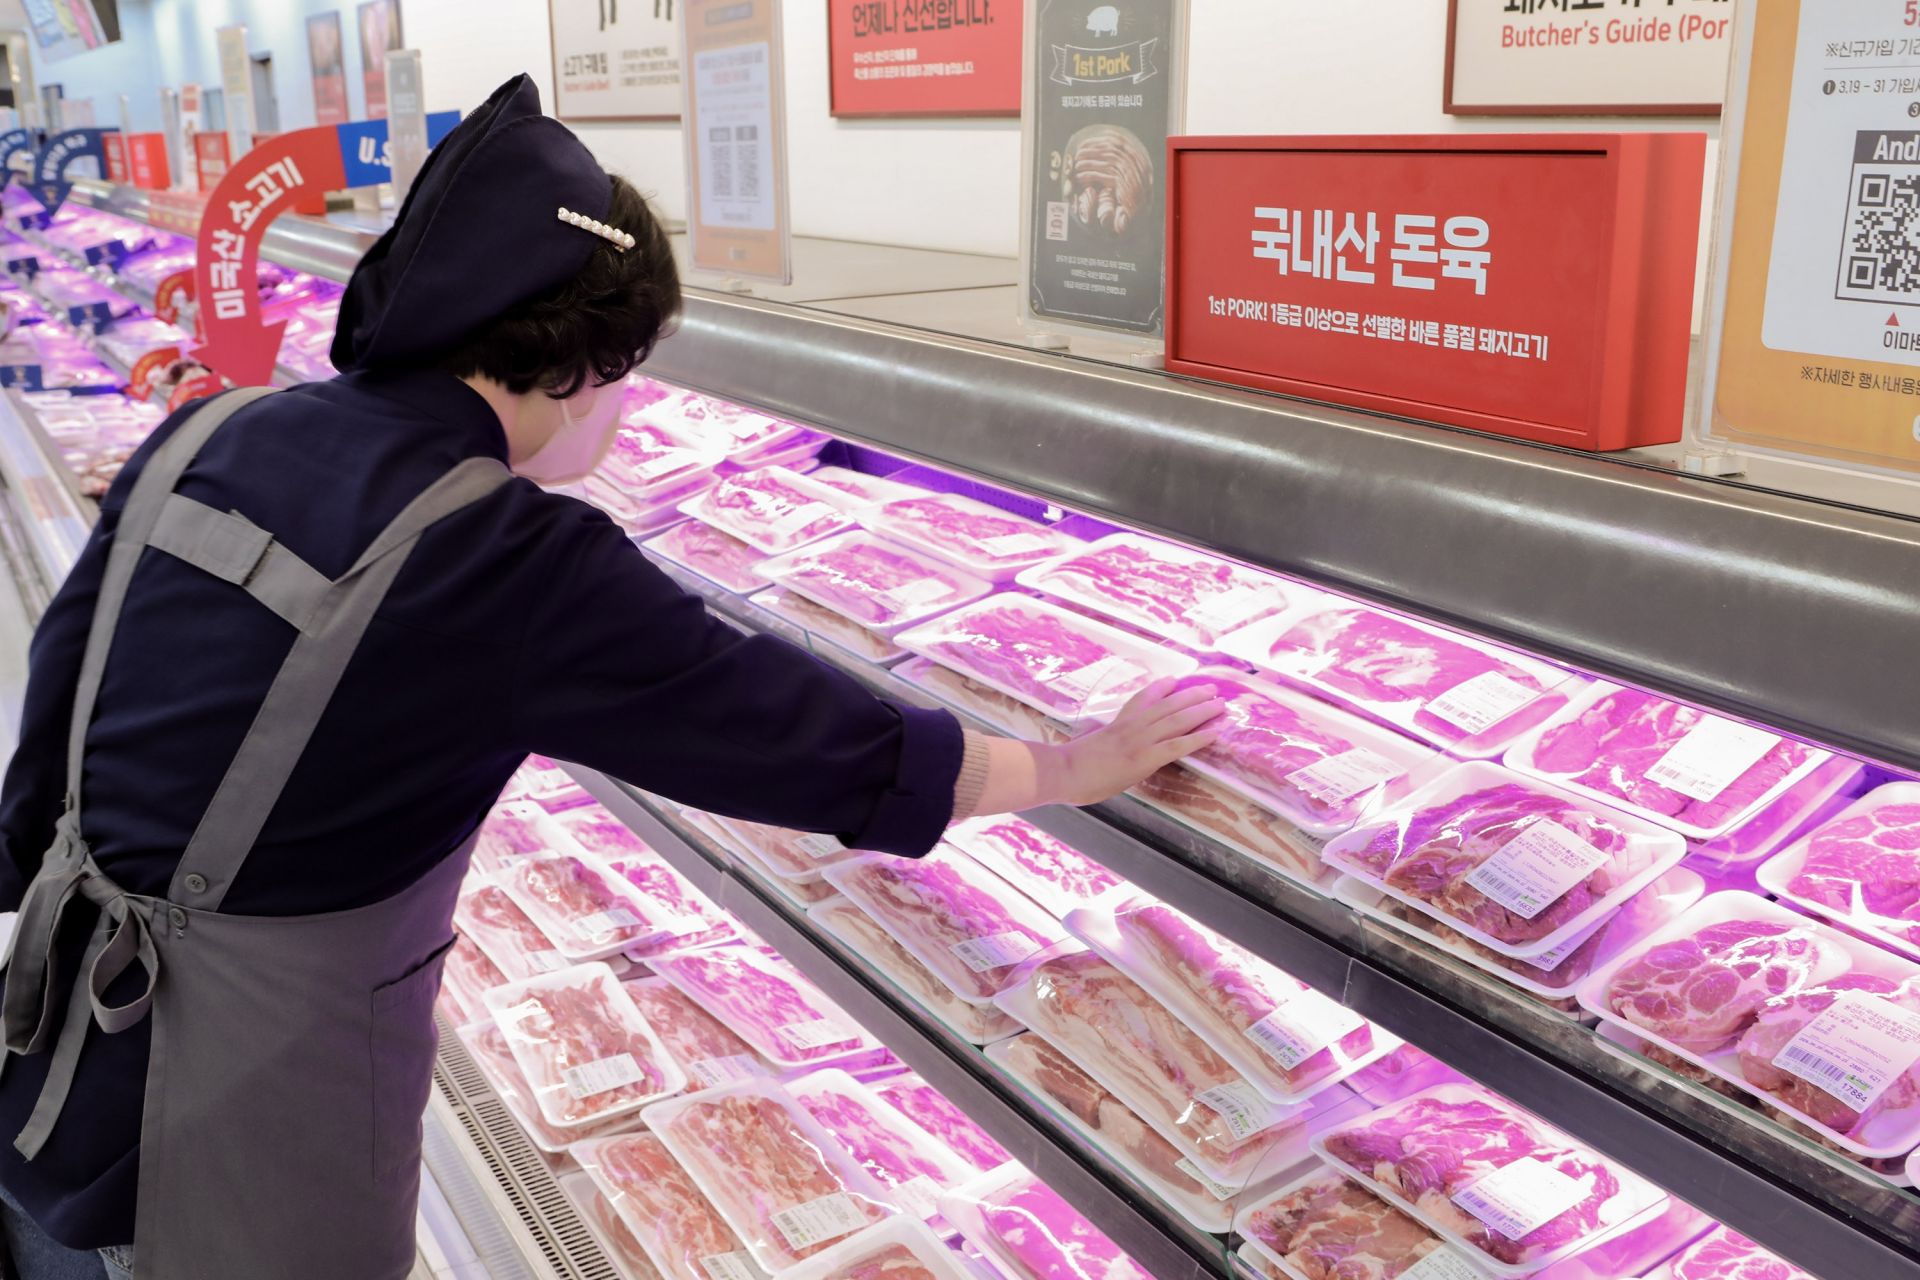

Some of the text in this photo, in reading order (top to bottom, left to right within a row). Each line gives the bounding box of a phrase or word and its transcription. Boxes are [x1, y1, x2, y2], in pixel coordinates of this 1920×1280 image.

[852, 1, 898, 38] 언제나
[1904, 0, 1920, 27] 5
[1501, 14, 1729, 48] Butcher's Guide (Por
[1072, 51, 1132, 77] 1st Pork
[1873, 79, 1886, 93] 31
[1873, 134, 1920, 162] And
[209, 156, 304, 320] 미국산 소고기
[1251, 206, 1491, 296] 국내산 돈육
[1208, 295, 1549, 362] 1st PORK! 1등급 이상으로 선별한 바른 품질 돼지고기
[1841, 1082, 1868, 1103] 17884
